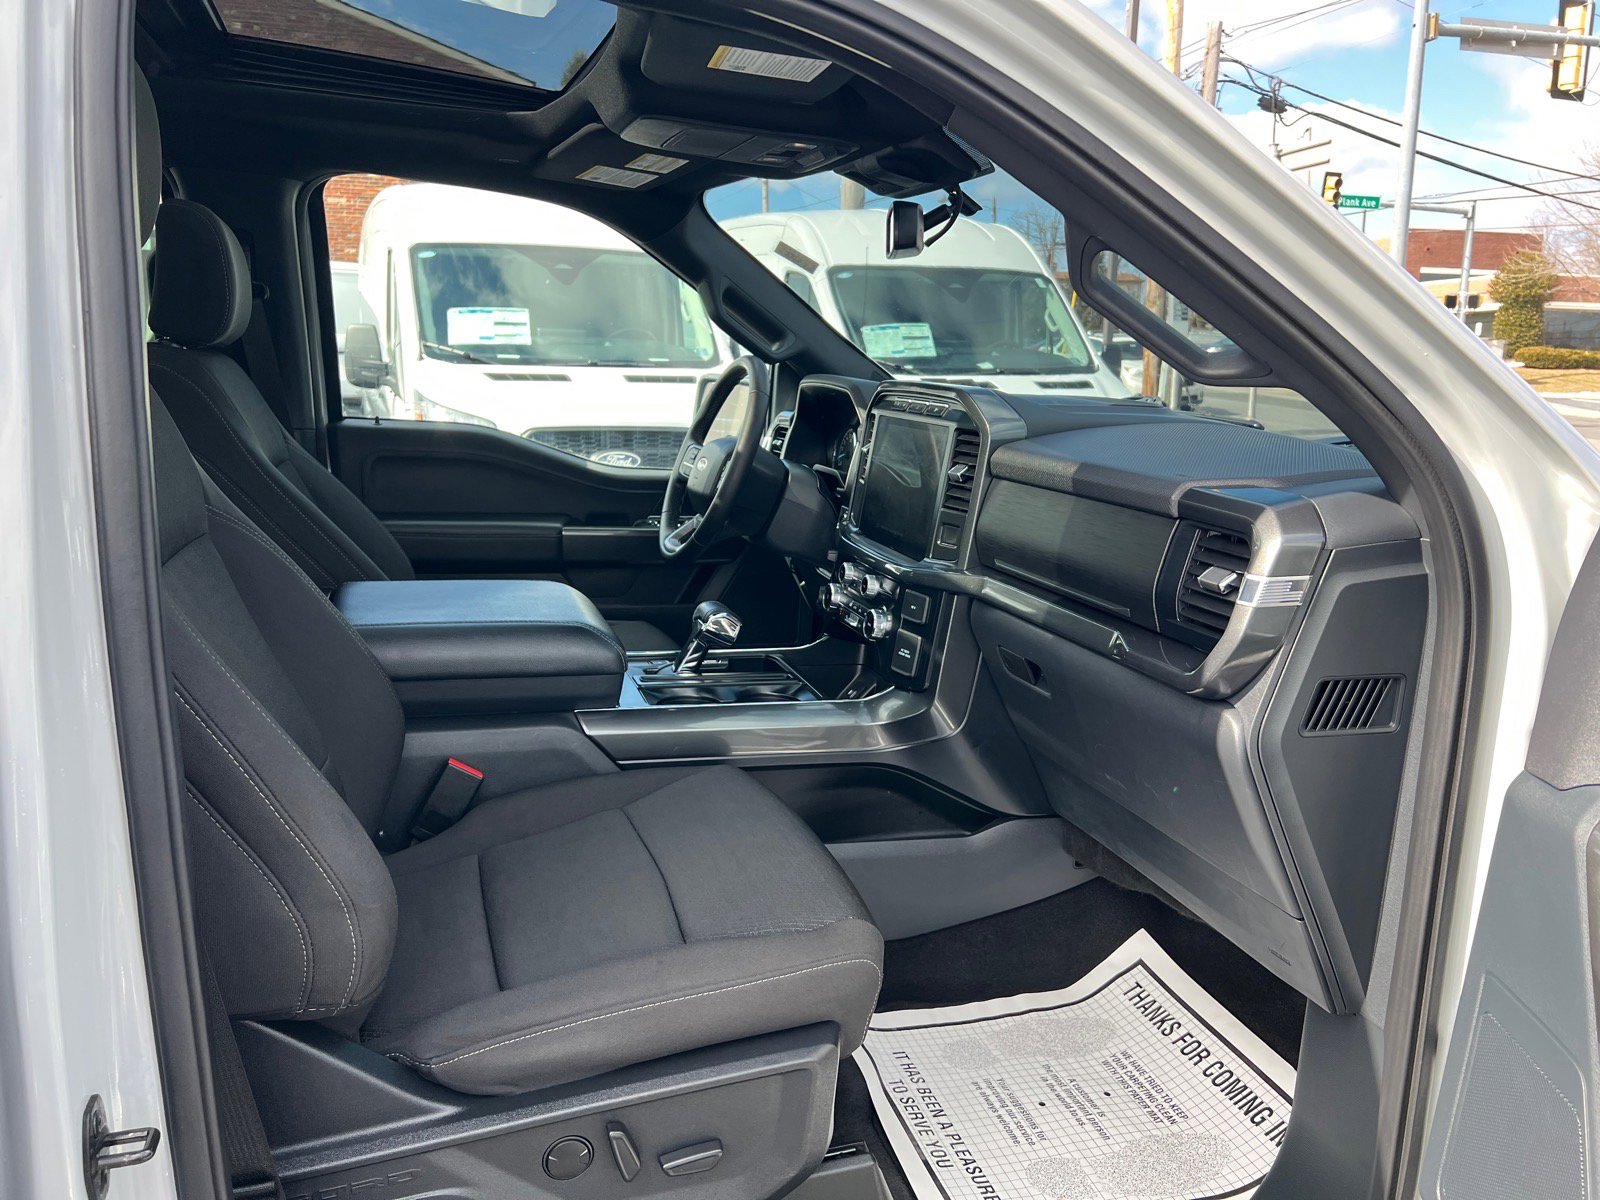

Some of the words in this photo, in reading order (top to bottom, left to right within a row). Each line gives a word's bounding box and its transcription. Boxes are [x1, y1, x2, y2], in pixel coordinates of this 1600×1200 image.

[1361, 198, 1376, 208] Ave
[892, 1051, 910, 1060] IT
[900, 1062, 926, 1084] HAS
[1120, 1050, 1133, 1060] WE
[1129, 1060, 1147, 1076] HAVE
[1144, 1075, 1164, 1094] TRIED
[1161, 1094, 1173, 1103] TO
[1169, 1103, 1189, 1120] KEEP
[1123, 982, 1182, 1037] THANKS
[1172, 1032, 1211, 1066] FOR
[1202, 1060, 1274, 1127] COMING
[917, 1087, 947, 1118] BEEN
[971, 1081, 982, 1091] are
[980, 1091, 999, 1114] always
[996, 1114, 1021, 1147] welcome.
[983, 1078, 1009, 1108] improving
[1005, 1108, 1018, 1120] our
[1014, 1120, 1036, 1146] service
[997, 1078, 1011, 1091] Your
[1006, 1091, 1038, 1130] suggestions
[1035, 1130, 1047, 1141] for
[1042, 1064, 1053, 1073] the
[1050, 1073, 1067, 1088] most
[1062, 1087, 1093, 1117] important
[1086, 1117, 1111, 1141] person
[1046, 1082, 1057, 1093] the
[1055, 1092, 1074, 1110] world
[1069, 1109, 1078, 1117] to
[1072, 1083, 1100, 1110] customer
[1097, 1110, 1106, 1118] is
[1102, 1060, 1120, 1075] WITH
[1115, 1075, 1132, 1089] THIS
[1128, 1089, 1150, 1109] PAPER
[1146, 1109, 1164, 1124] MAT
[1110, 1053, 1128, 1070] YOUR
[1124, 1070, 1158, 1103] CARPETING
[1154, 1103, 1178, 1125] CLEAN
[889, 1079, 908, 1094] TO
[900, 1097, 935, 1136] SERVE
[925, 1140, 954, 1169] YOU
[937, 1121, 954, 1130] A
